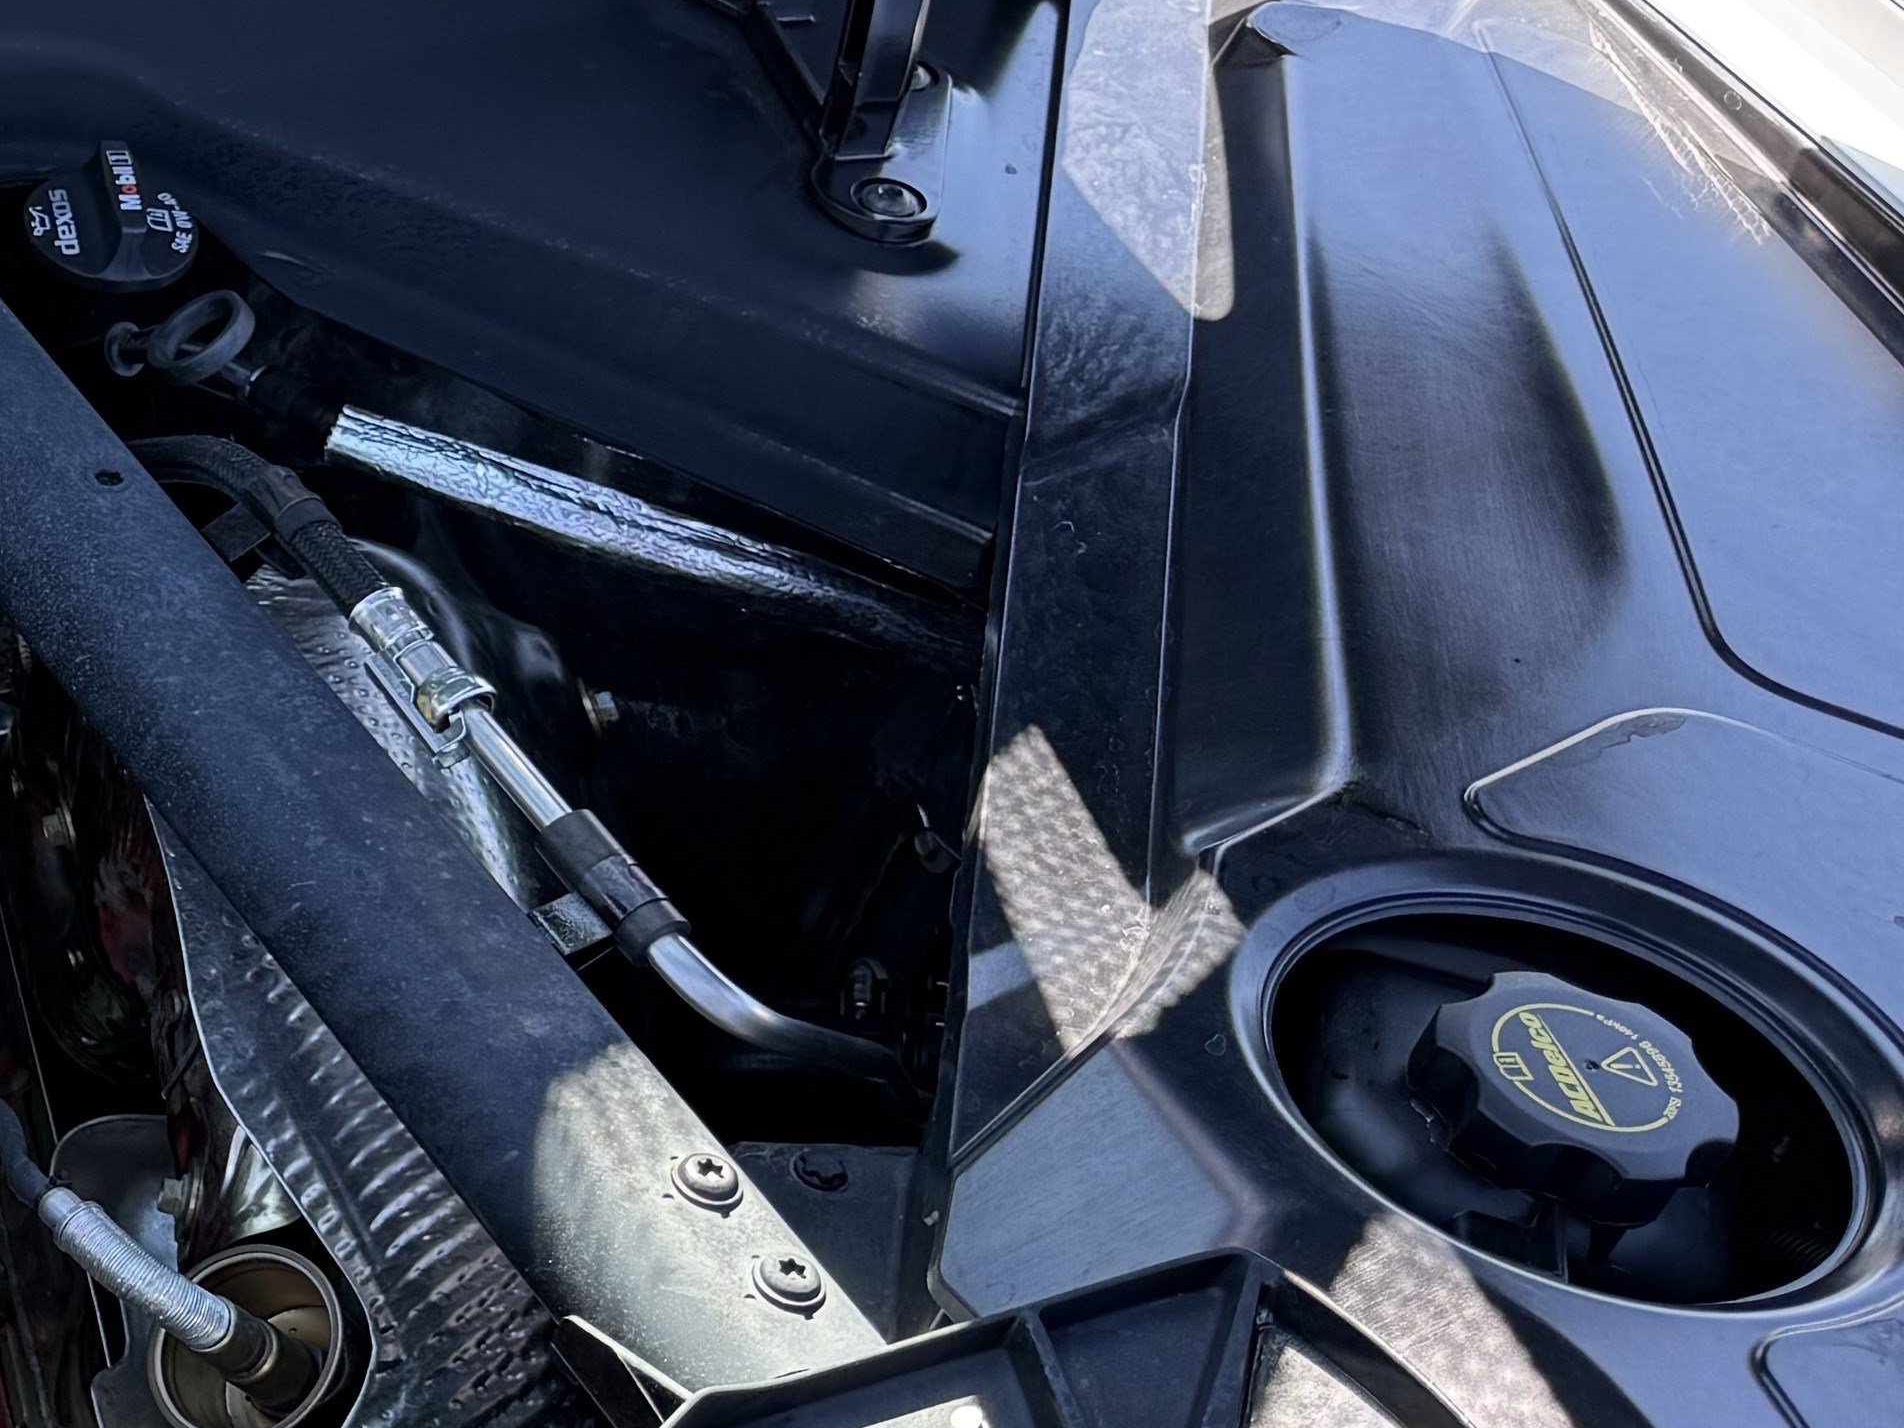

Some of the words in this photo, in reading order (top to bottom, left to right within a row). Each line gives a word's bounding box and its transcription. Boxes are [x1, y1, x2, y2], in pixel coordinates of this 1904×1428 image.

[111, 165, 143, 211] Mobil
[47, 188, 81, 256] dexos
[171, 231, 193, 254] SAE
[1518, 1011, 1605, 1122] ACDelco
